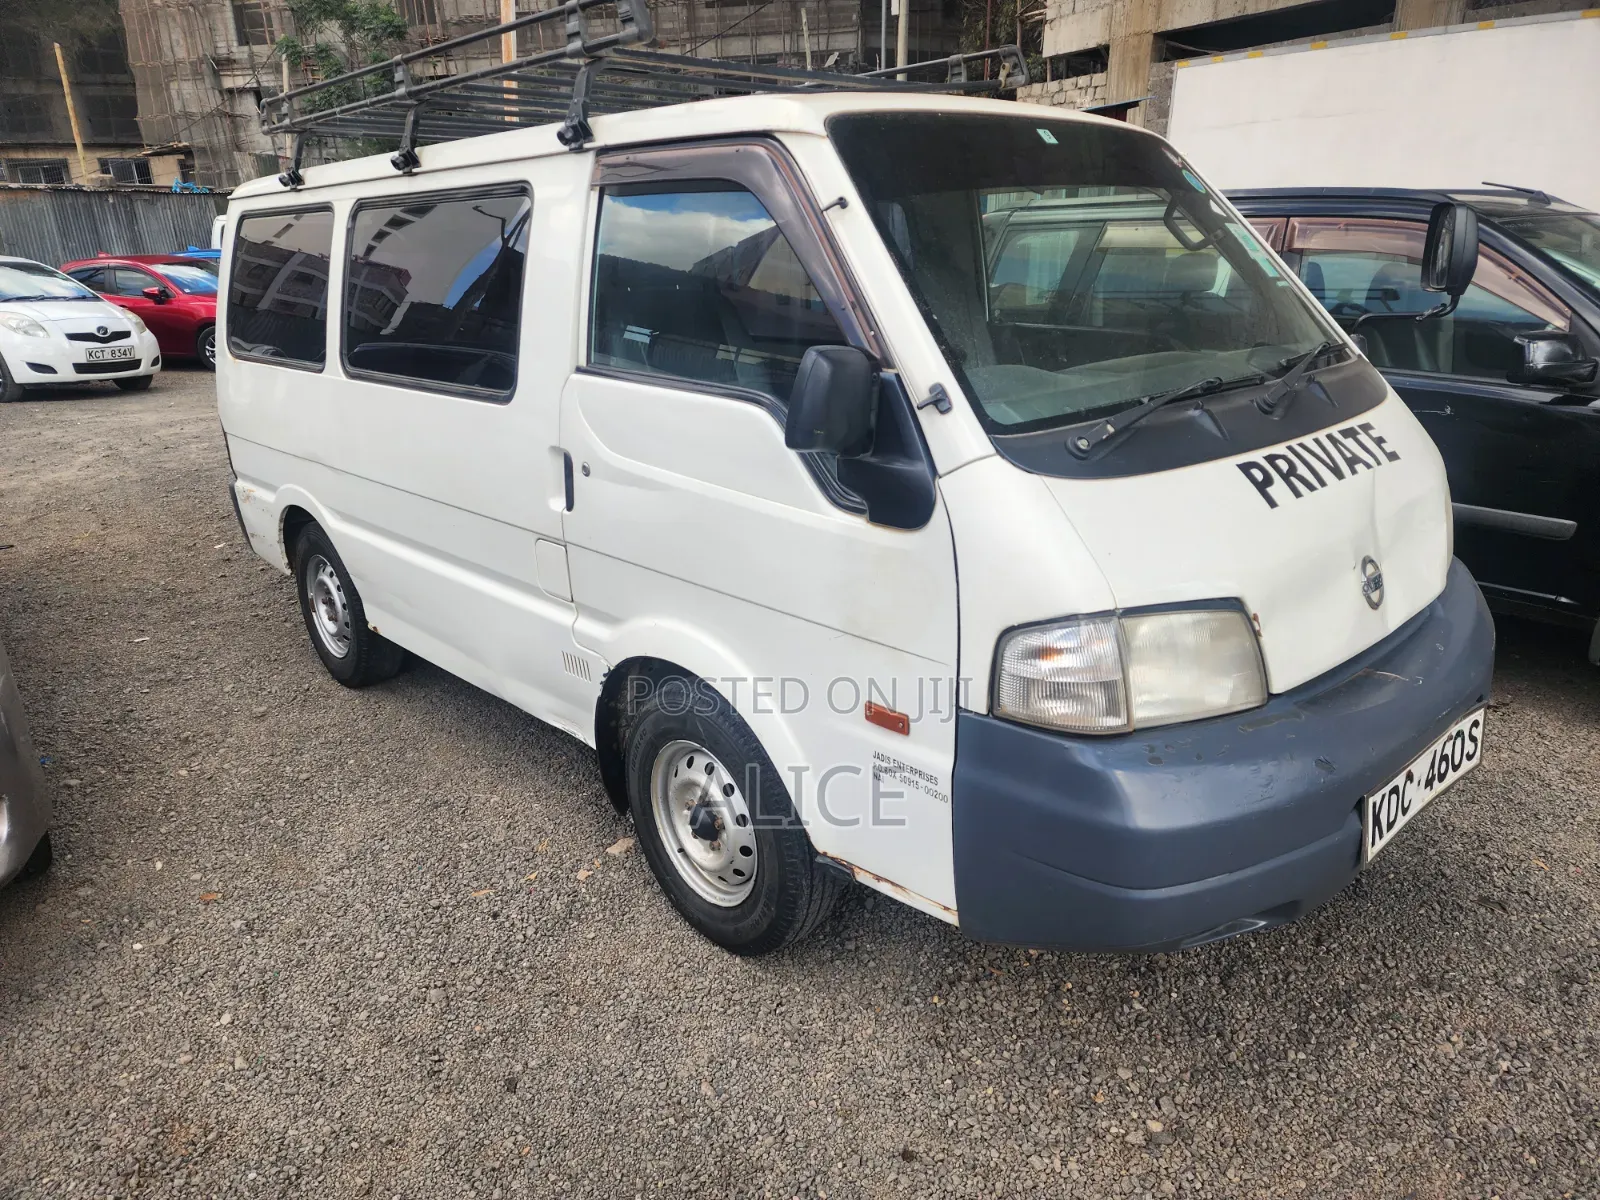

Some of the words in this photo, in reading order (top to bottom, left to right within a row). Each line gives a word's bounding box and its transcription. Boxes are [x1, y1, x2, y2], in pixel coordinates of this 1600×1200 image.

[88, 350, 105, 359] KCT
[111, 348, 132, 358] 834V
[1236, 422, 1401, 509] PRIVATE
[873, 751, 892, 765] JADIS
[893, 759, 938, 786] ENTERPRISES
[1371, 769, 1414, 848] KDC
[1424, 719, 1480, 791] 460S
